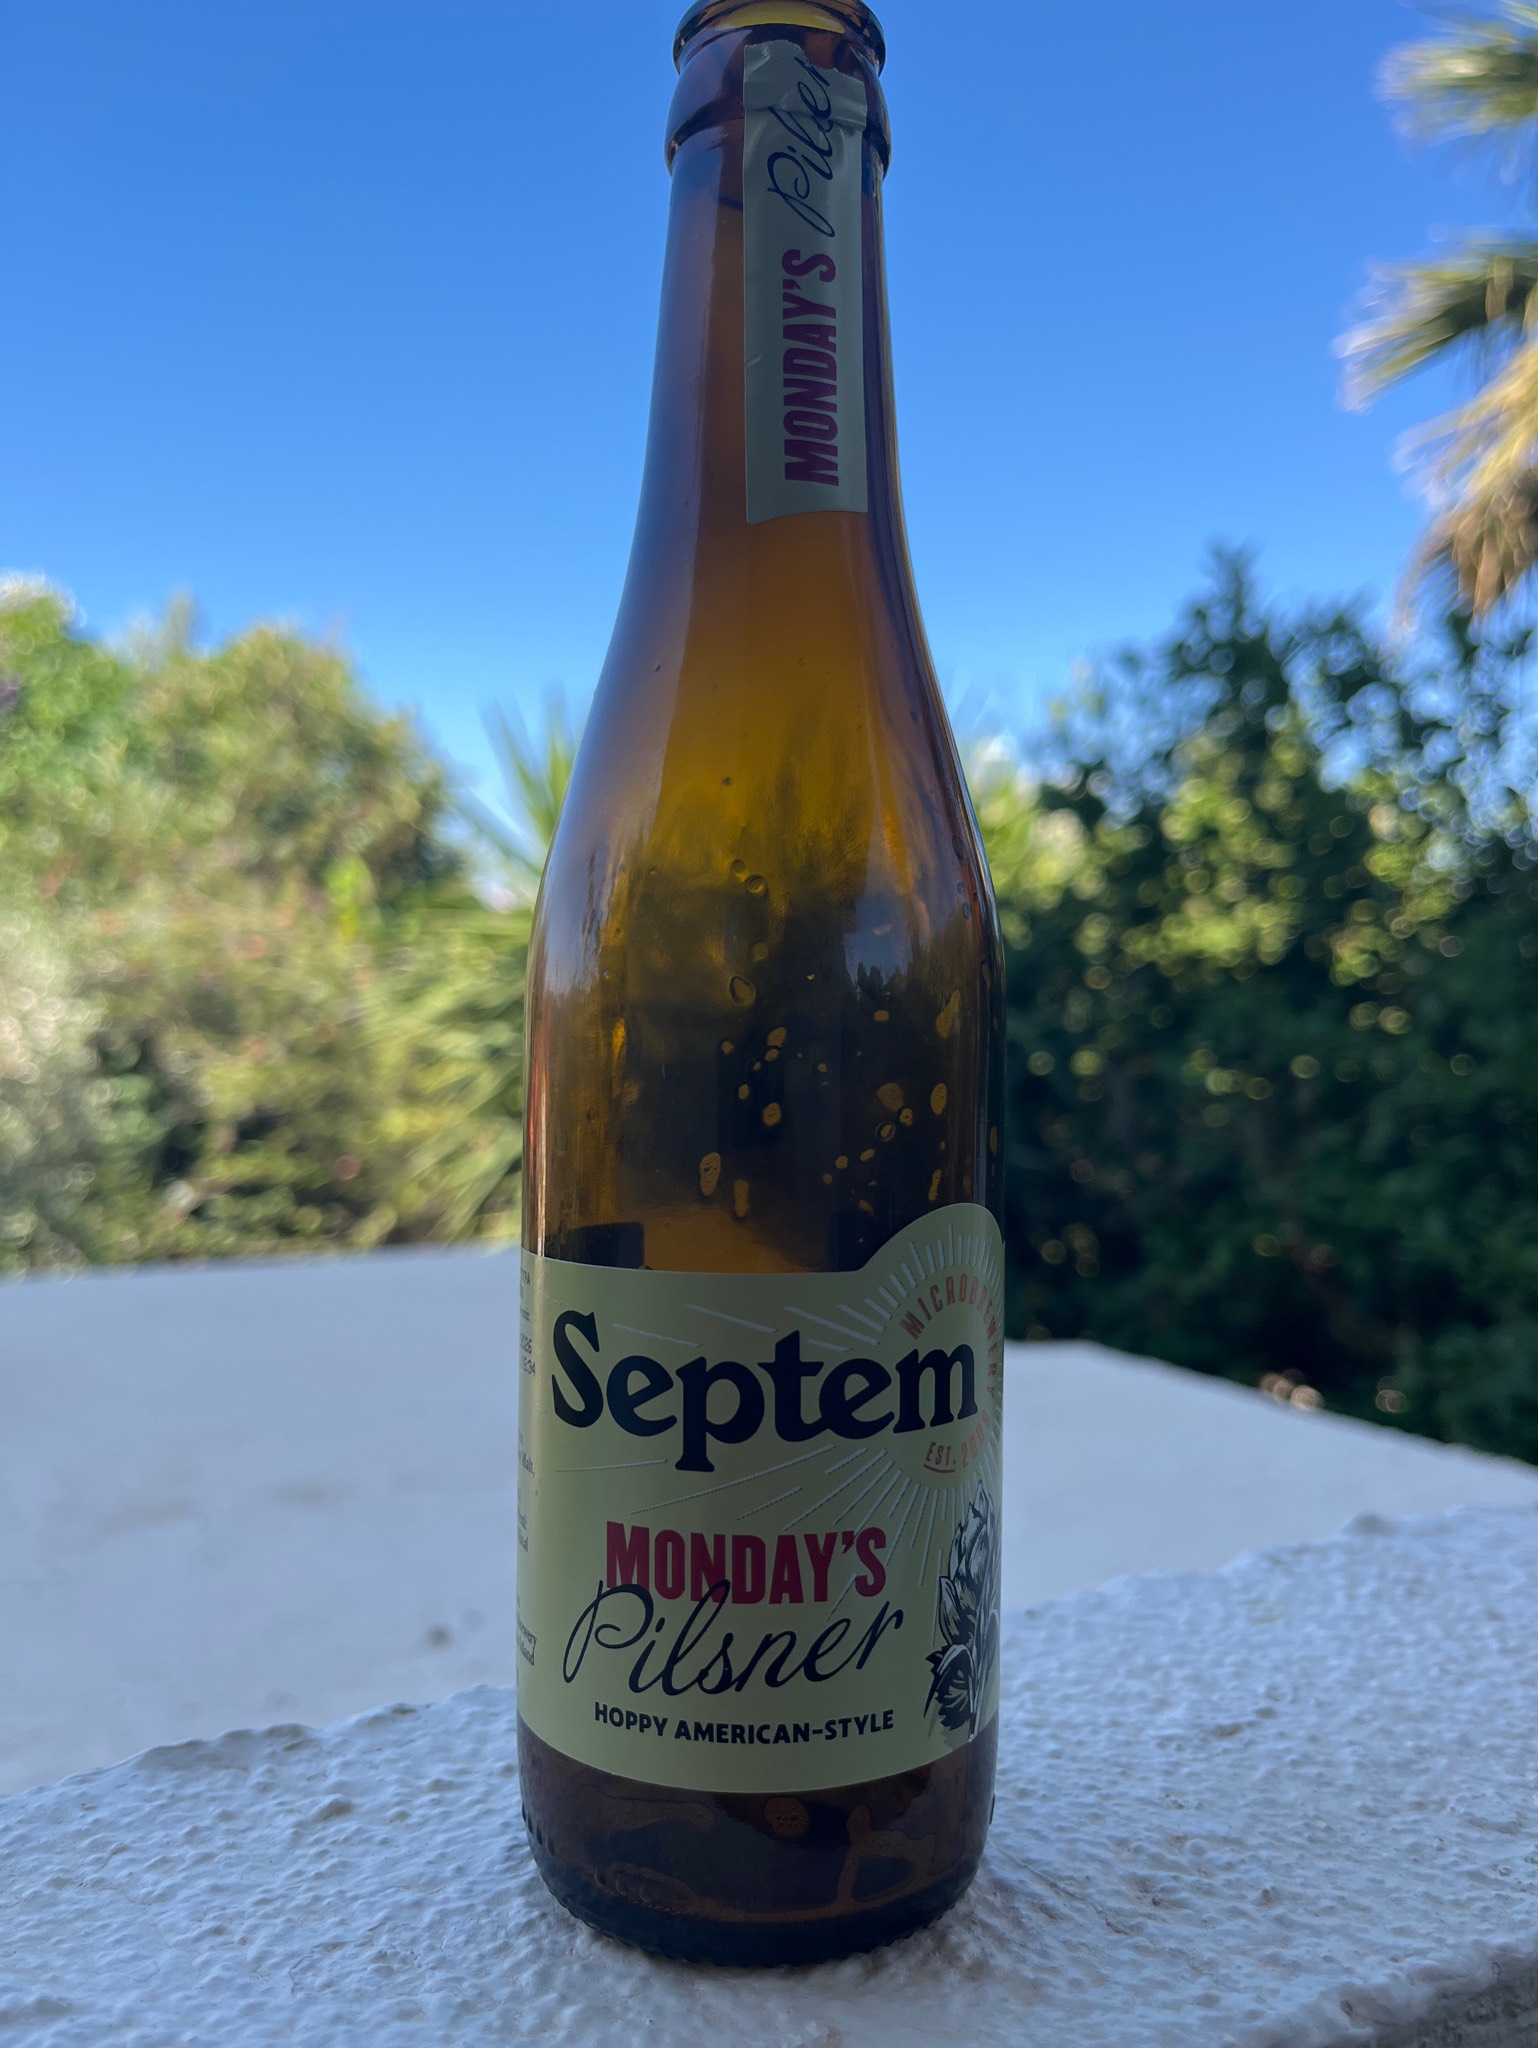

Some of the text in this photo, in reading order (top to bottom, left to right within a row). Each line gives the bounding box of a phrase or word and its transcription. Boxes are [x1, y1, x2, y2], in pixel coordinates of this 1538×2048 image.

[781, 249, 839, 486] MONDAY'S
[552, 1310, 978, 1473] Septem
[925, 1441, 956, 1467] EST.
[605, 1520, 887, 1605] MONDAY'S
[562, 1579, 904, 1696] Pilsner
[594, 1701, 895, 1745] HOPPY AMERICAN-STYLE
